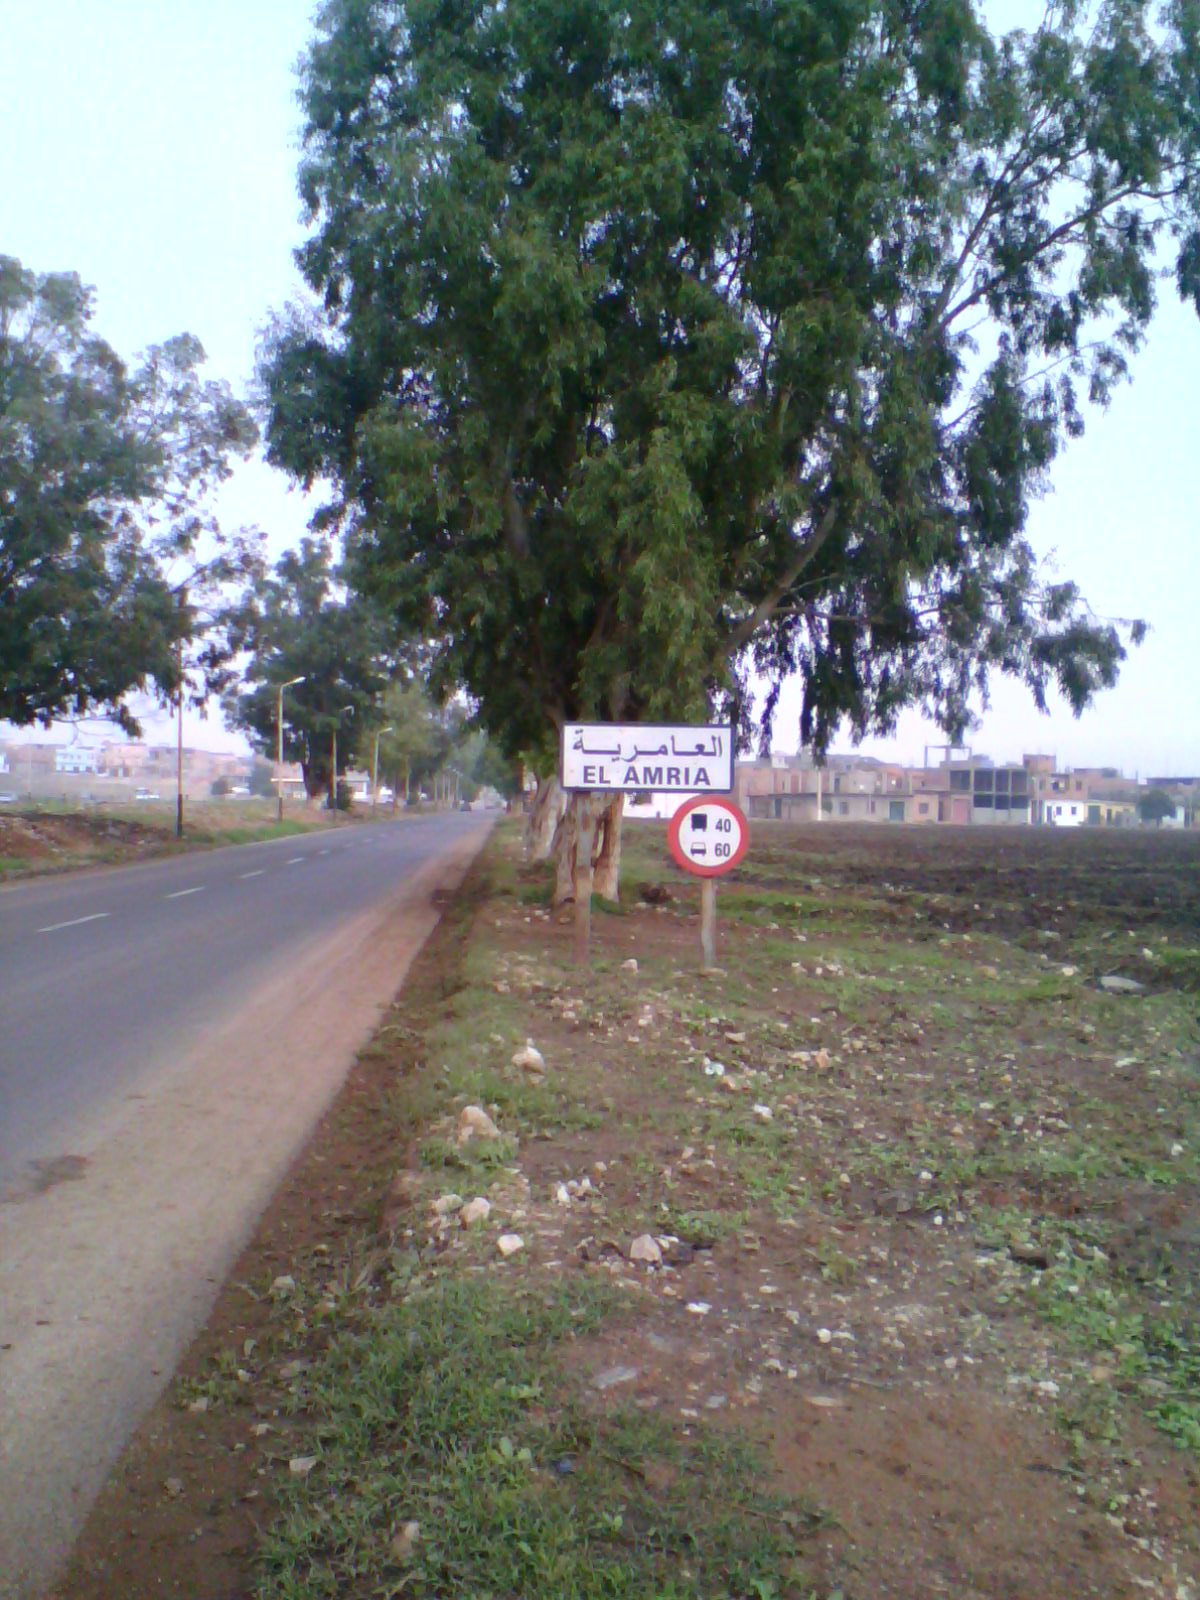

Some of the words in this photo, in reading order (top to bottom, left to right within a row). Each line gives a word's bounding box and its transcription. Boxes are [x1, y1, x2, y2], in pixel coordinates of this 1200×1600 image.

[572, 728, 723, 763] العامرية
[583, 765, 611, 784] EL
[623, 766, 711, 786] AMRIA
[715, 818, 731, 833] 40
[714, 842, 731, 857] 60
